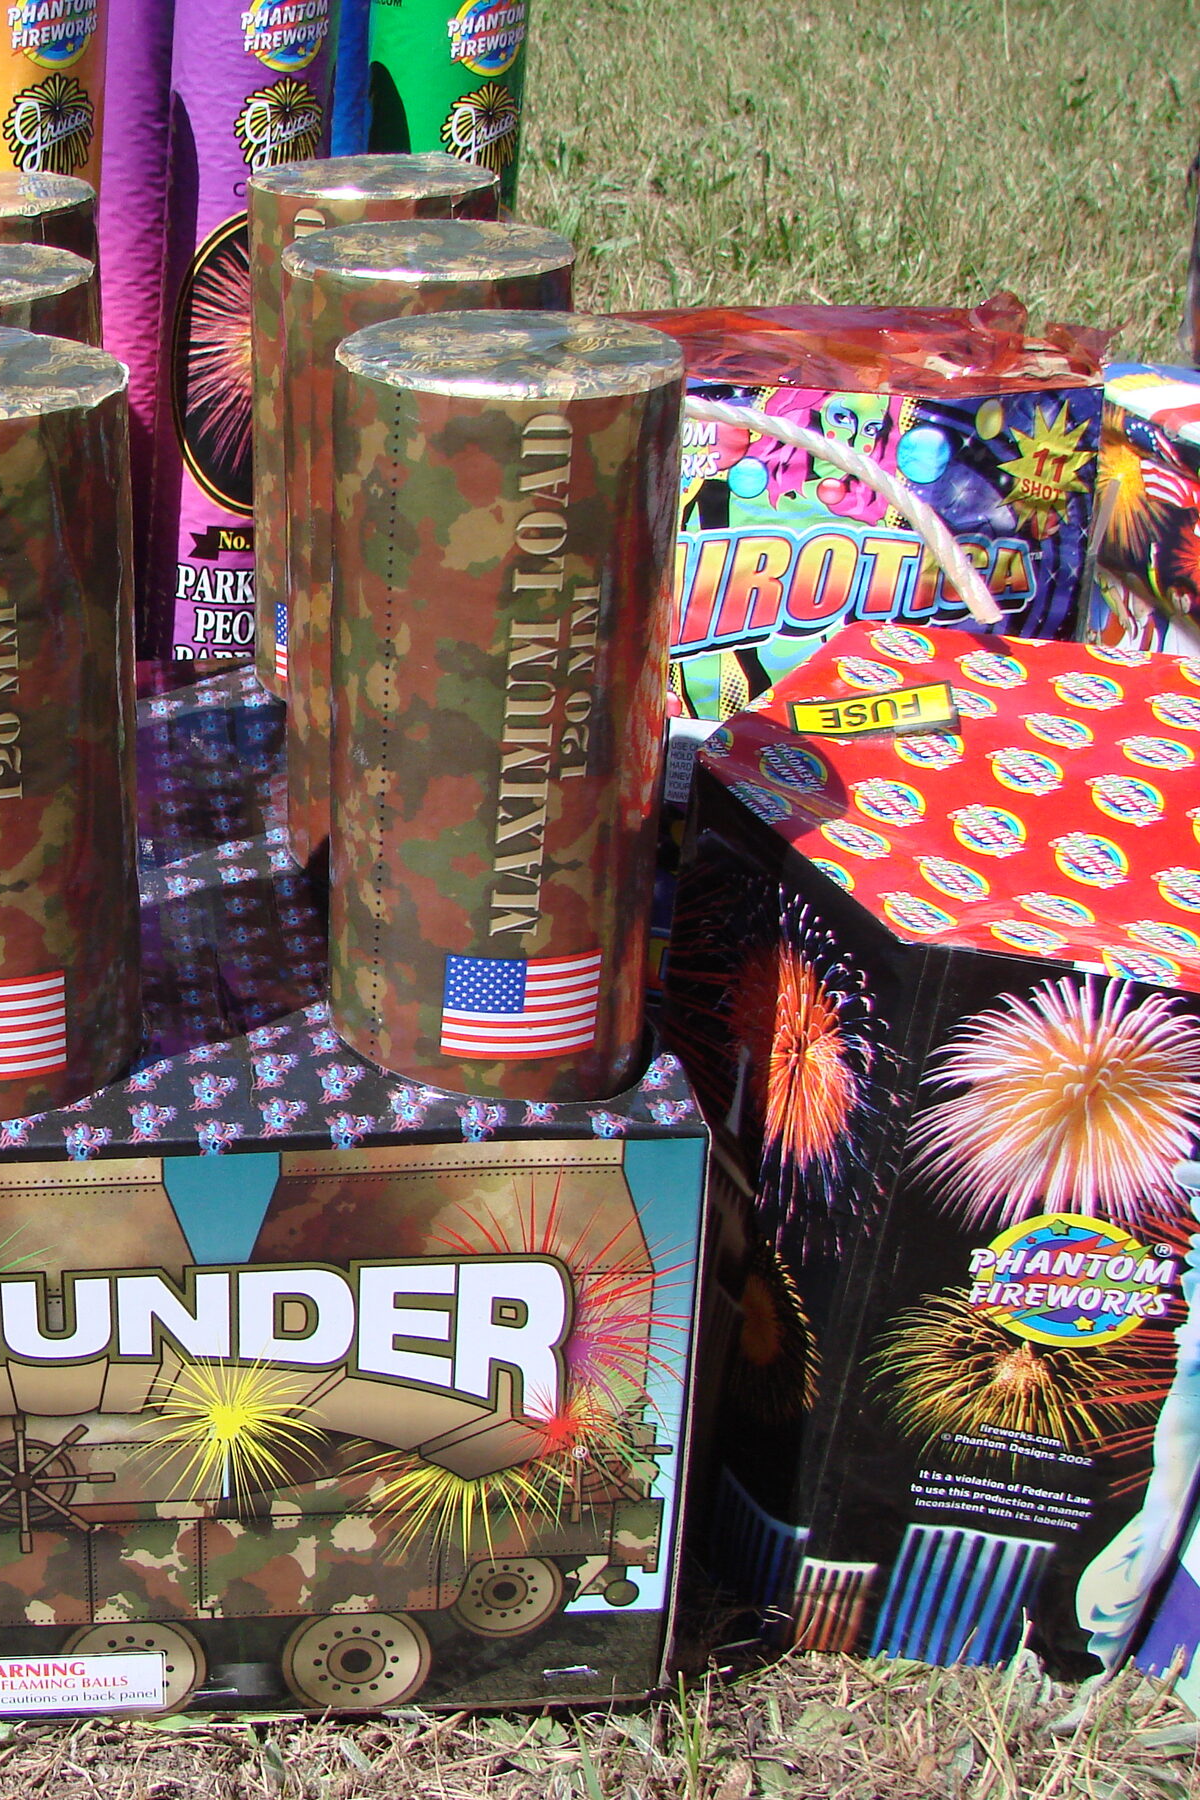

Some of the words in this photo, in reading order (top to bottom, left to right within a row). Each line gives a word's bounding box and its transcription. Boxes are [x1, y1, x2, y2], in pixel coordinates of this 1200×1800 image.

[7, 0, 97, 27] PHANTOM
[11, 12, 98, 49] FIREWORKS
[241, 0, 328, 30] PHANTOM
[447, 3, 525, 38] PHANTOM
[244, 20, 329, 52] FIREWORKS
[450, 23, 525, 59] FIREWORKS
[1032, 448, 1069, 483] 11
[512, 414, 573, 592] LOAD
[1022, 478, 1063, 503] SHOT
[218, 530, 250, 549] No.
[567, 583, 601, 676] MM
[820, 693, 920, 730] FUSE
[560, 691, 593, 781] 120
[489, 618, 561, 937] MAXIMUM
[968, 1248, 1176, 1285] PHANTOM
[968, 1281, 1173, 1317] FIREWORKS
[954, 1434, 1007, 1450] Phantom
[1009, 1443, 1055, 1461] Designs
[1057, 1453, 1093, 1467] 2002
[979, 1423, 1061, 1447] fireworks.com
[910, 1483, 922, 1493] to
[925, 1487, 946, 1496] use
[948, 1486, 971, 1498] this
[1036, 1503, 1045, 1511] a
[1047, 1506, 1093, 1518] manner
[919, 1469, 931, 1479] It
[932, 1470, 942, 1480] is
[944, 1474, 952, 1482] a
[955, 1474, 1005, 1490] violation
[1007, 1483, 1020, 1493] of
[1021, 1485, 1065, 1501] Federal
[1066, 1493, 1092, 1505] Law
[915, 1498, 986, 1514] inconsistent
[987, 1507, 1013, 1518] with
[1015, 1511, 1031, 1522] its
[1033, 1515, 1079, 1530] labeling
[1, 1678, 76, 1691] FLAMING
[82, 1675, 128, 1688] BALLS
[1, 1692, 58, 1704] cautions
[62, 1693, 79, 1703] on
[83, 1691, 116, 1702] back
[119, 1688, 158, 1703] panel
